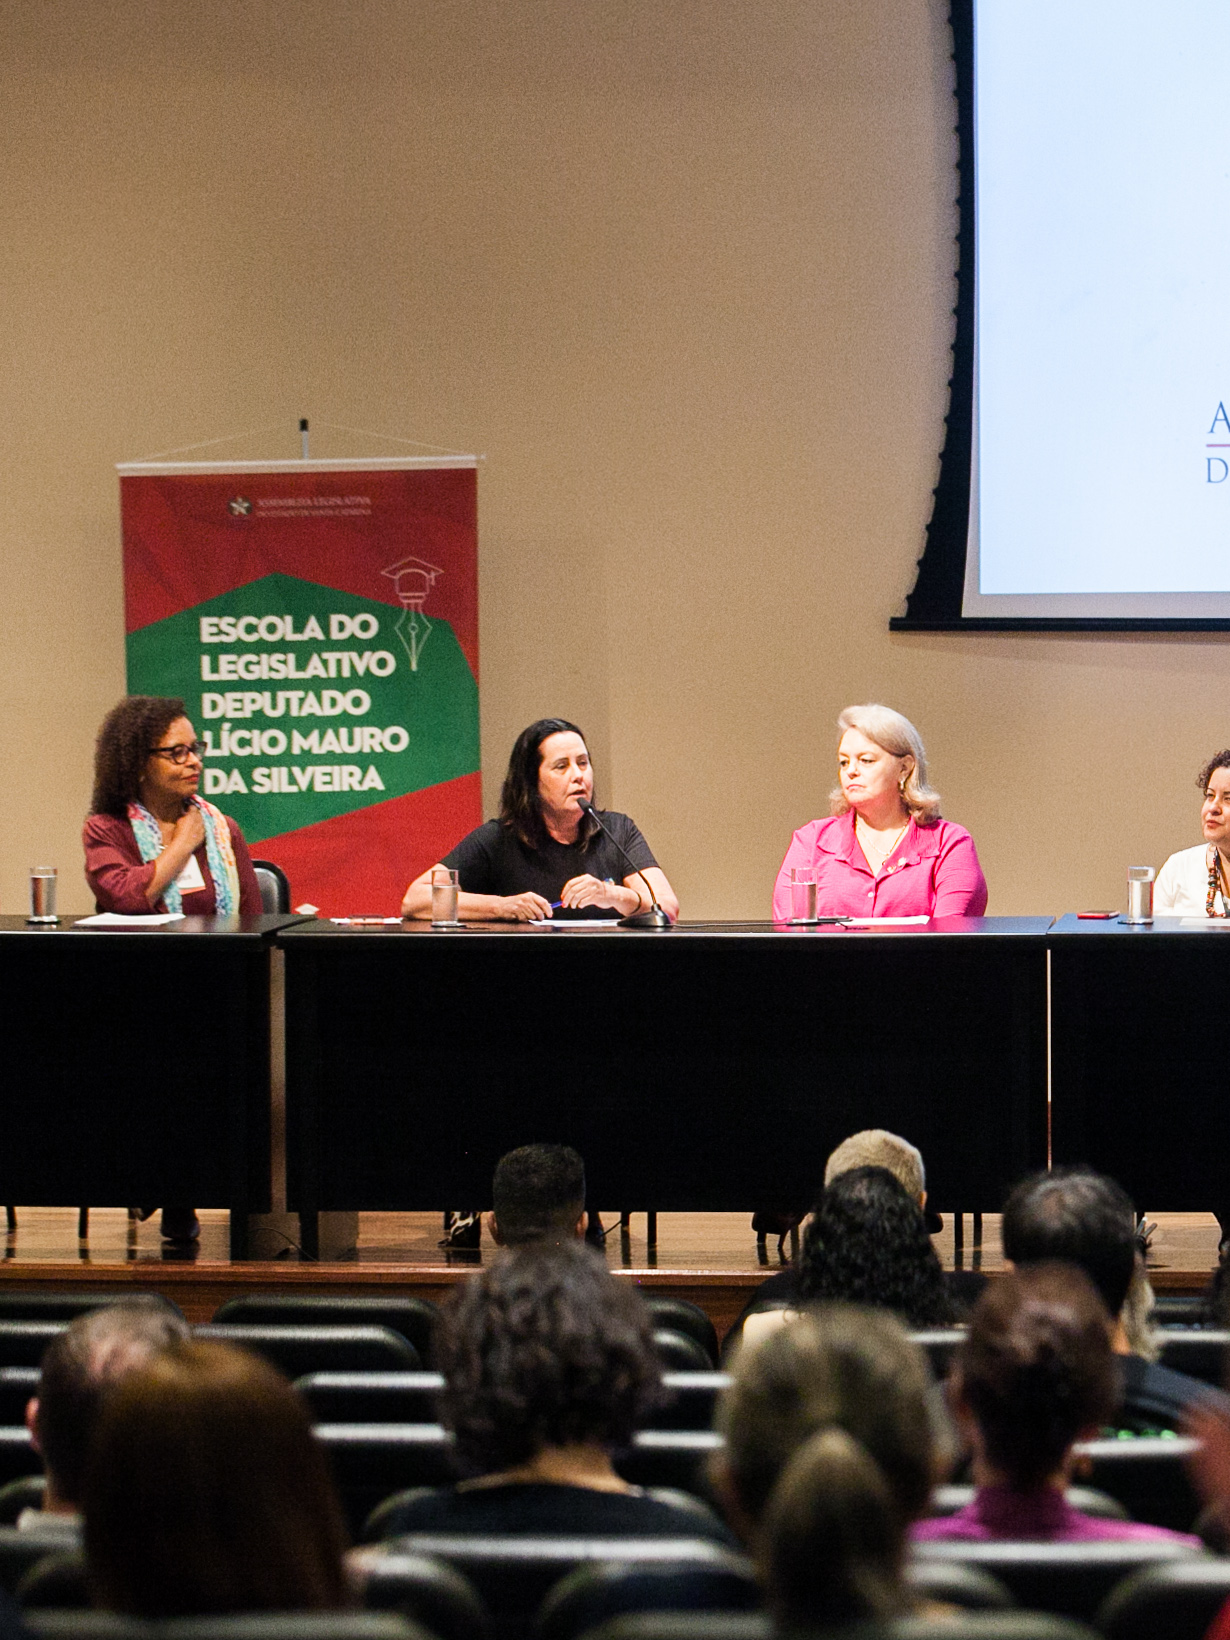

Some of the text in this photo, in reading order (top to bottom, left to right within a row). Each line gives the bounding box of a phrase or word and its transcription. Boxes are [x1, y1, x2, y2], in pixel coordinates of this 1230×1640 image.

[200, 613, 379, 643] ESCOLA DO
[201, 651, 396, 681] LEGISLATIVO
[202, 689, 371, 719] DEPUTADO
[203, 723, 410, 757] LÍCIO MAURO
[204, 764, 385, 795] DA SILVEIRA
